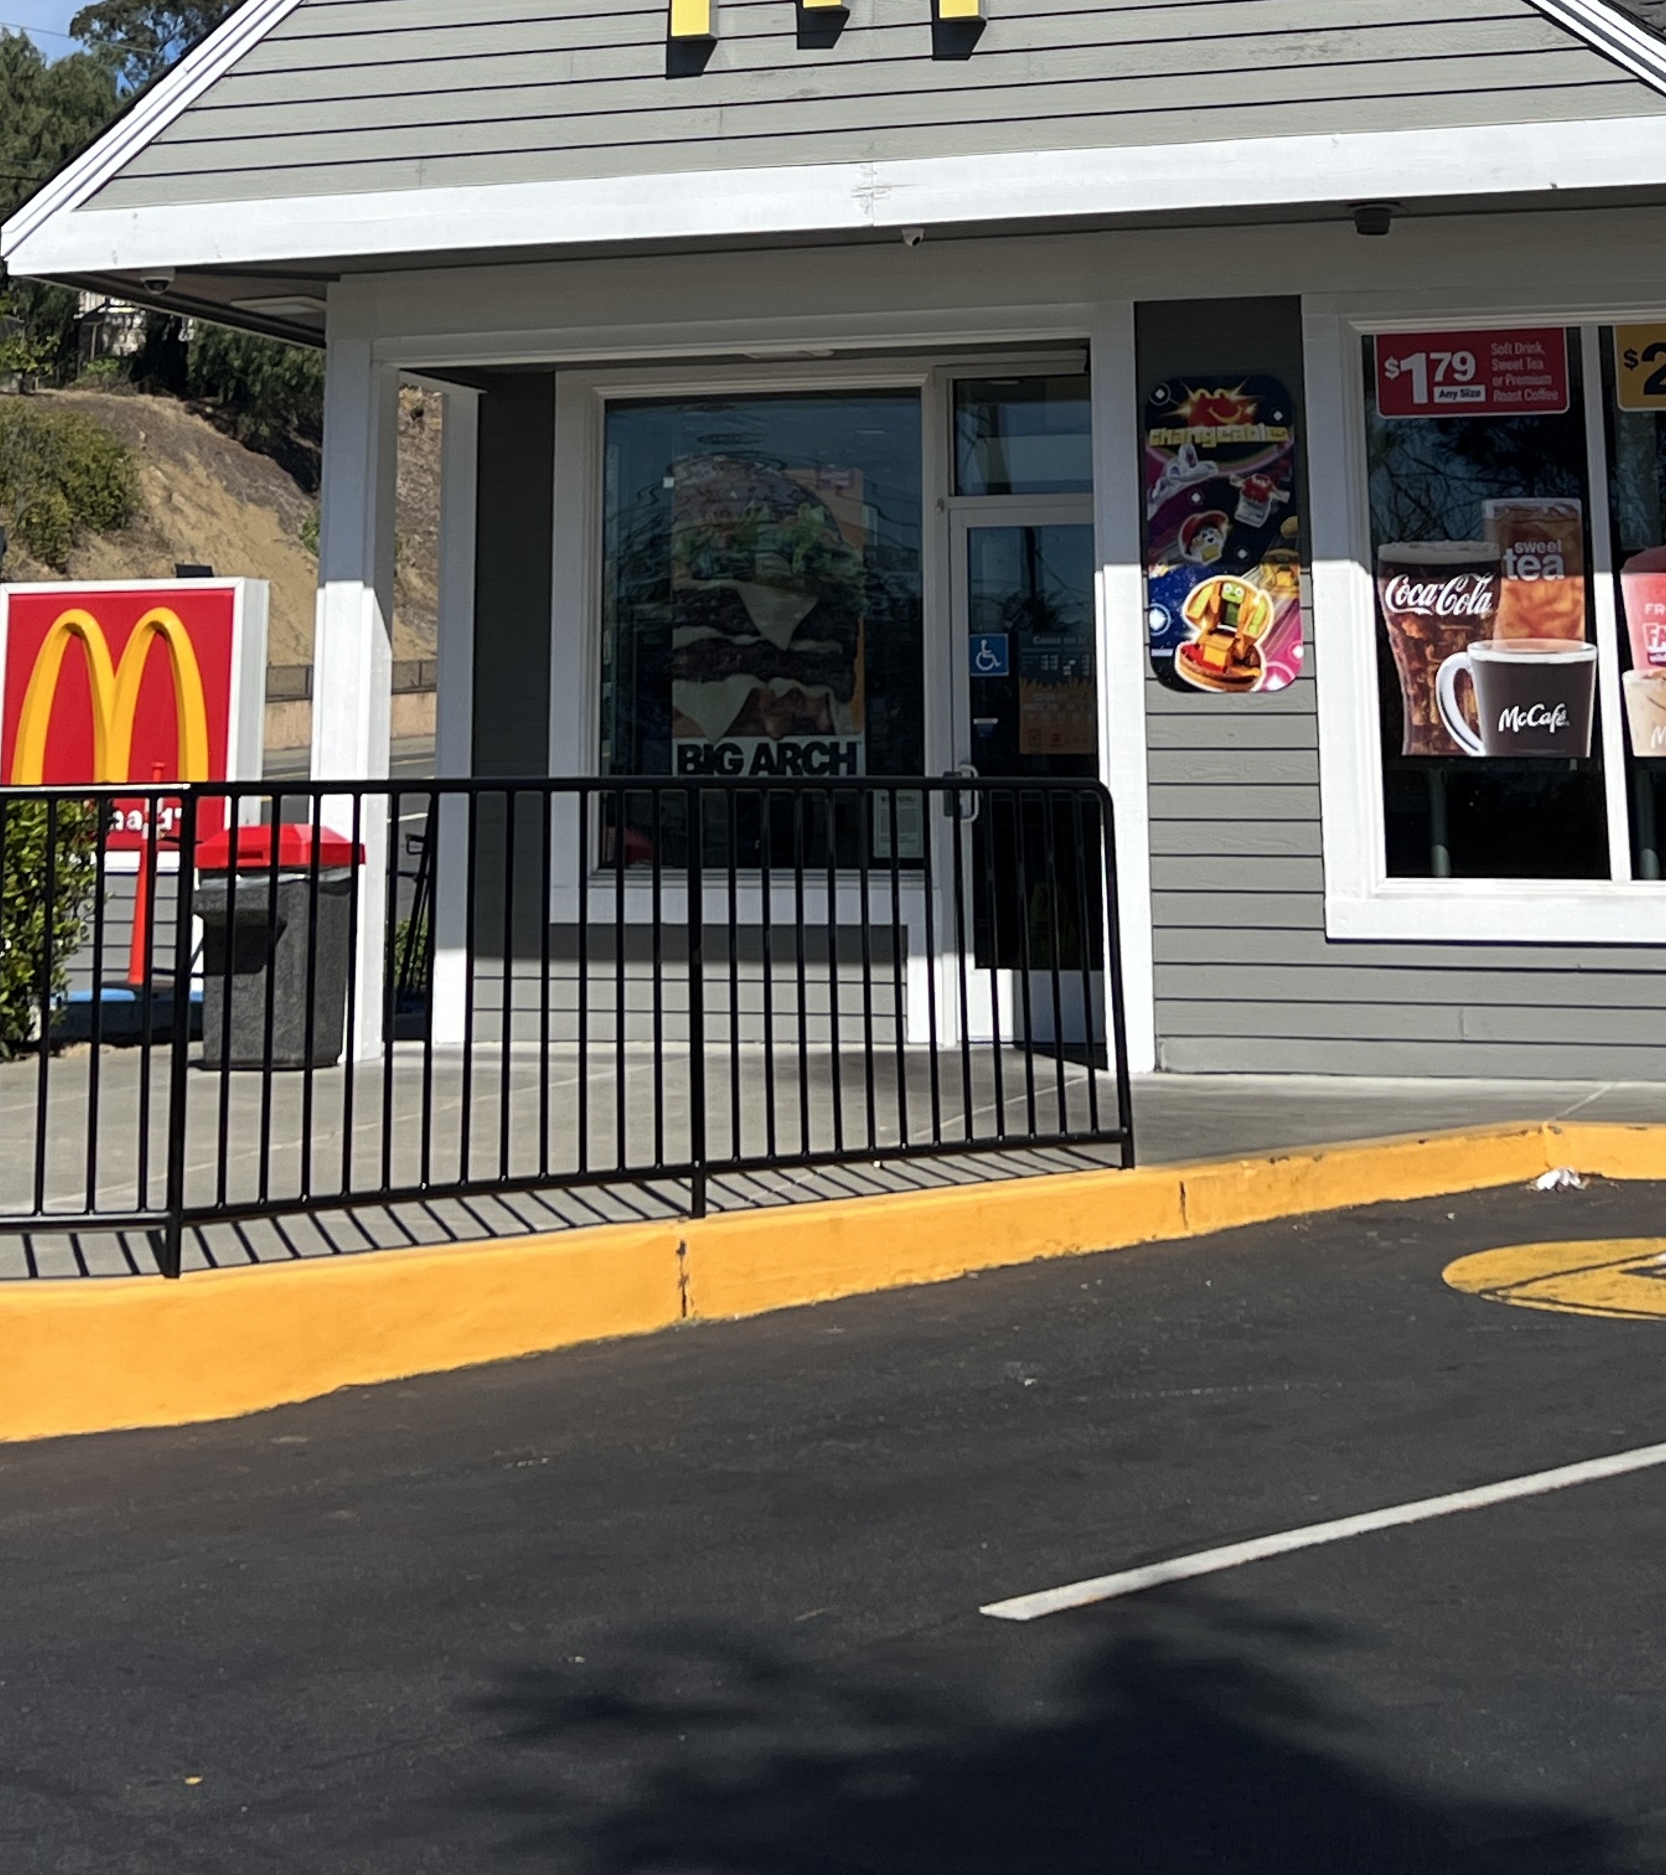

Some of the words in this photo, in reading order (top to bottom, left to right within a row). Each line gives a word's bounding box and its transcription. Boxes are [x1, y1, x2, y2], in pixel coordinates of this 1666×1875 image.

[1490, 342, 1513, 356] Soft
[1491, 357, 1523, 371] Sweet
[1525, 356, 1544, 370] Tea
[1438, 389, 1458, 400] Any
[1460, 388, 1481, 398] Size
[1524, 388, 1559, 401] Coffee
[1514, 539, 1563, 554] sweet
[1504, 547, 1565, 581] tea
[1498, 703, 1568, 733] McCafé
[677, 743, 744, 775] BIG
[749, 741, 857, 775] ARCH
